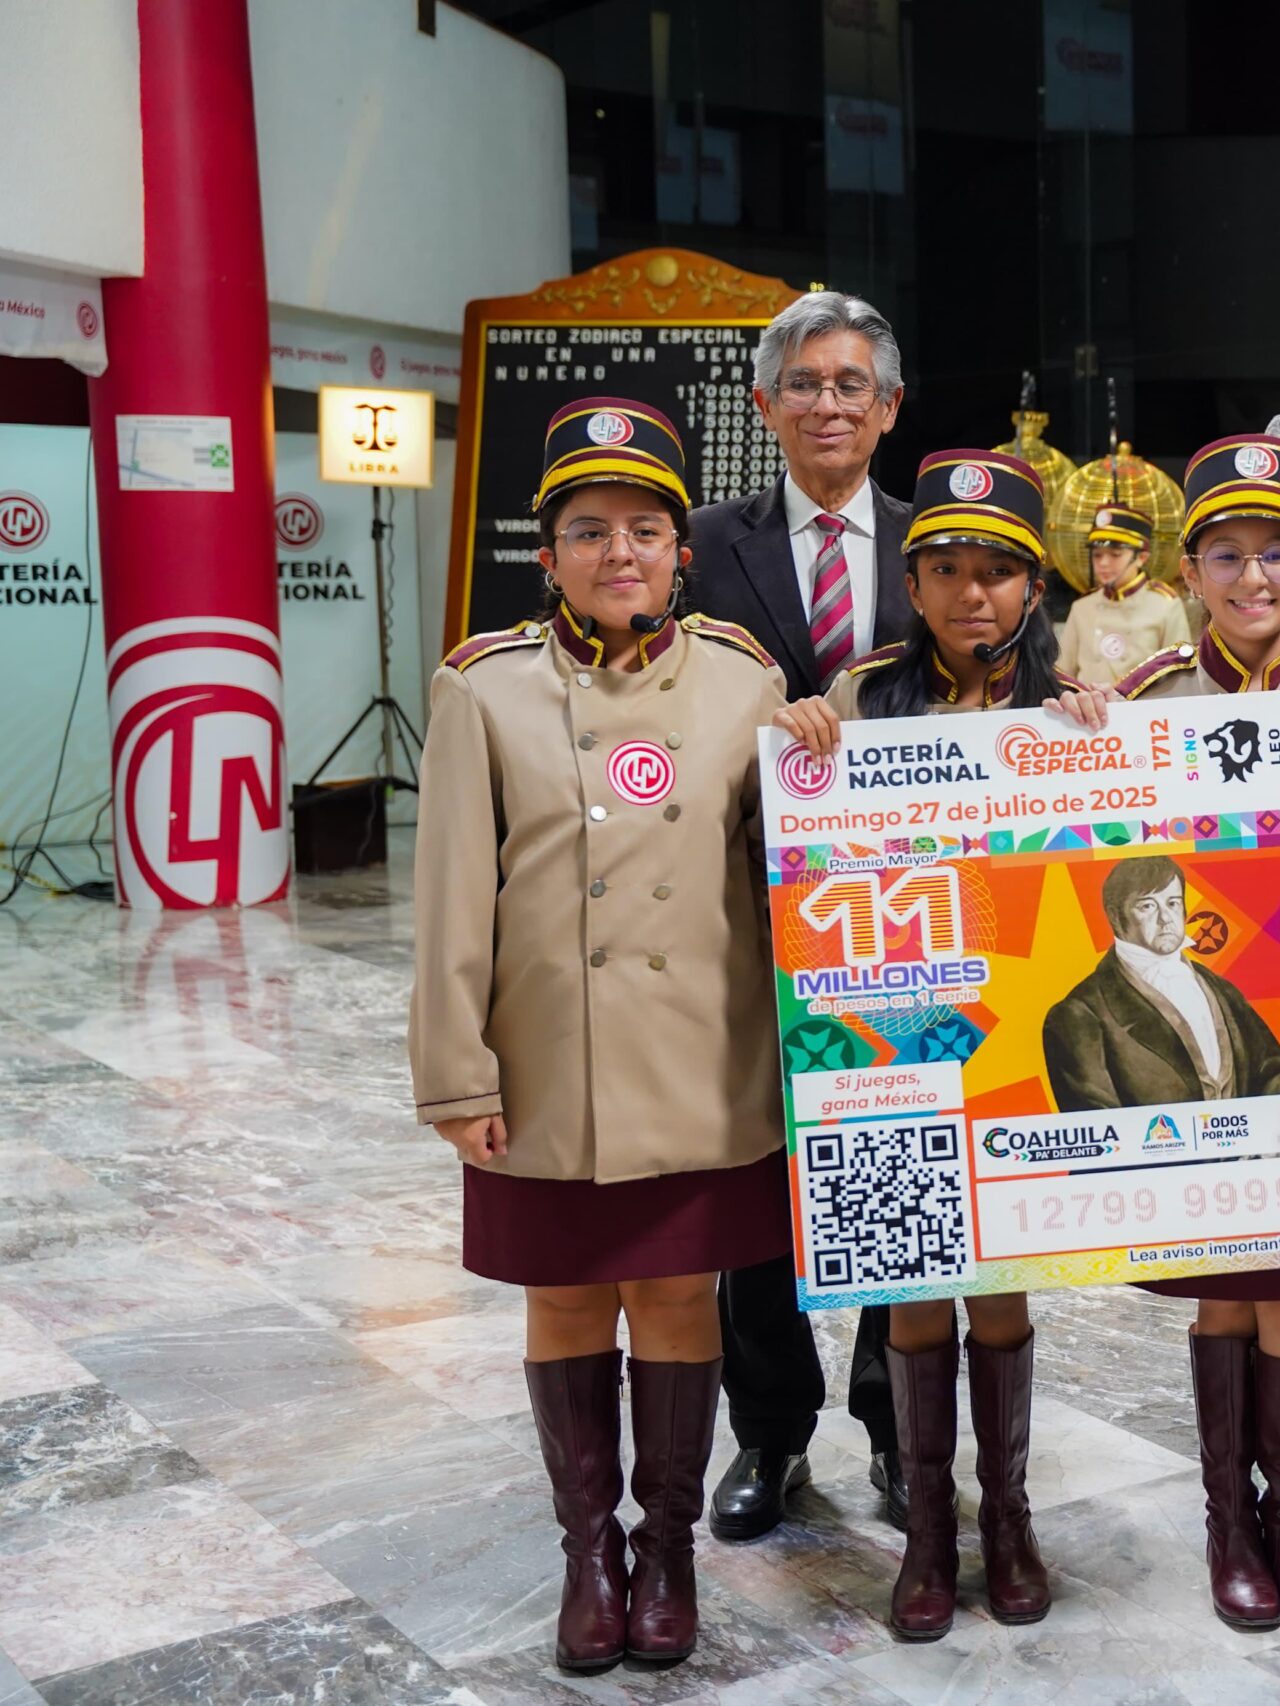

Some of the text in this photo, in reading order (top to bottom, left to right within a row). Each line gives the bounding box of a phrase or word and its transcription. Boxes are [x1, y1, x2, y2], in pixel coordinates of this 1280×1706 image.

[487, 328, 557, 344] SORTEO
[568, 328, 642, 344] ZODIACO
[658, 328, 746, 344] ESPECIAL
[545, 347, 572, 362] EN
[611, 347, 656, 362] UNA
[495, 365, 606, 381] NUMERO
[0, 588, 98, 604] IONAL
[281, 584, 365, 600] IONAL
[847, 738, 965, 767] LOTERÍA
[1017, 736, 1122, 759] ZODIACO
[1150, 718, 1172, 771] 1712
[1183, 728, 1199, 781] SIGNO
[849, 763, 989, 789] NACIONAL
[1017, 754, 1132, 777] ESPECIAL
[780, 786, 1158, 834] Domingo 27 de julio de 2025
[829, 853, 938, 871] Premio Mayor
[805, 872, 957, 961] 11
[797, 960, 986, 996] MILLONES
[809, 988, 978, 1014] de pesos en 1 serie
[835, 1073, 921, 1092] Si juegas,
[821, 1091, 938, 1115] gana México
[1199, 1113, 1248, 1129] TODOS
[982, 1125, 1120, 1158] COAHUILA
[1202, 1127, 1249, 1140] POR MÁS
[1053, 1146, 1097, 1158] DELANTE
[1011, 1187, 1157, 1233] 12799
[1130, 1247, 1158, 1262] Lea
[1162, 1242, 1204, 1259] aviso
